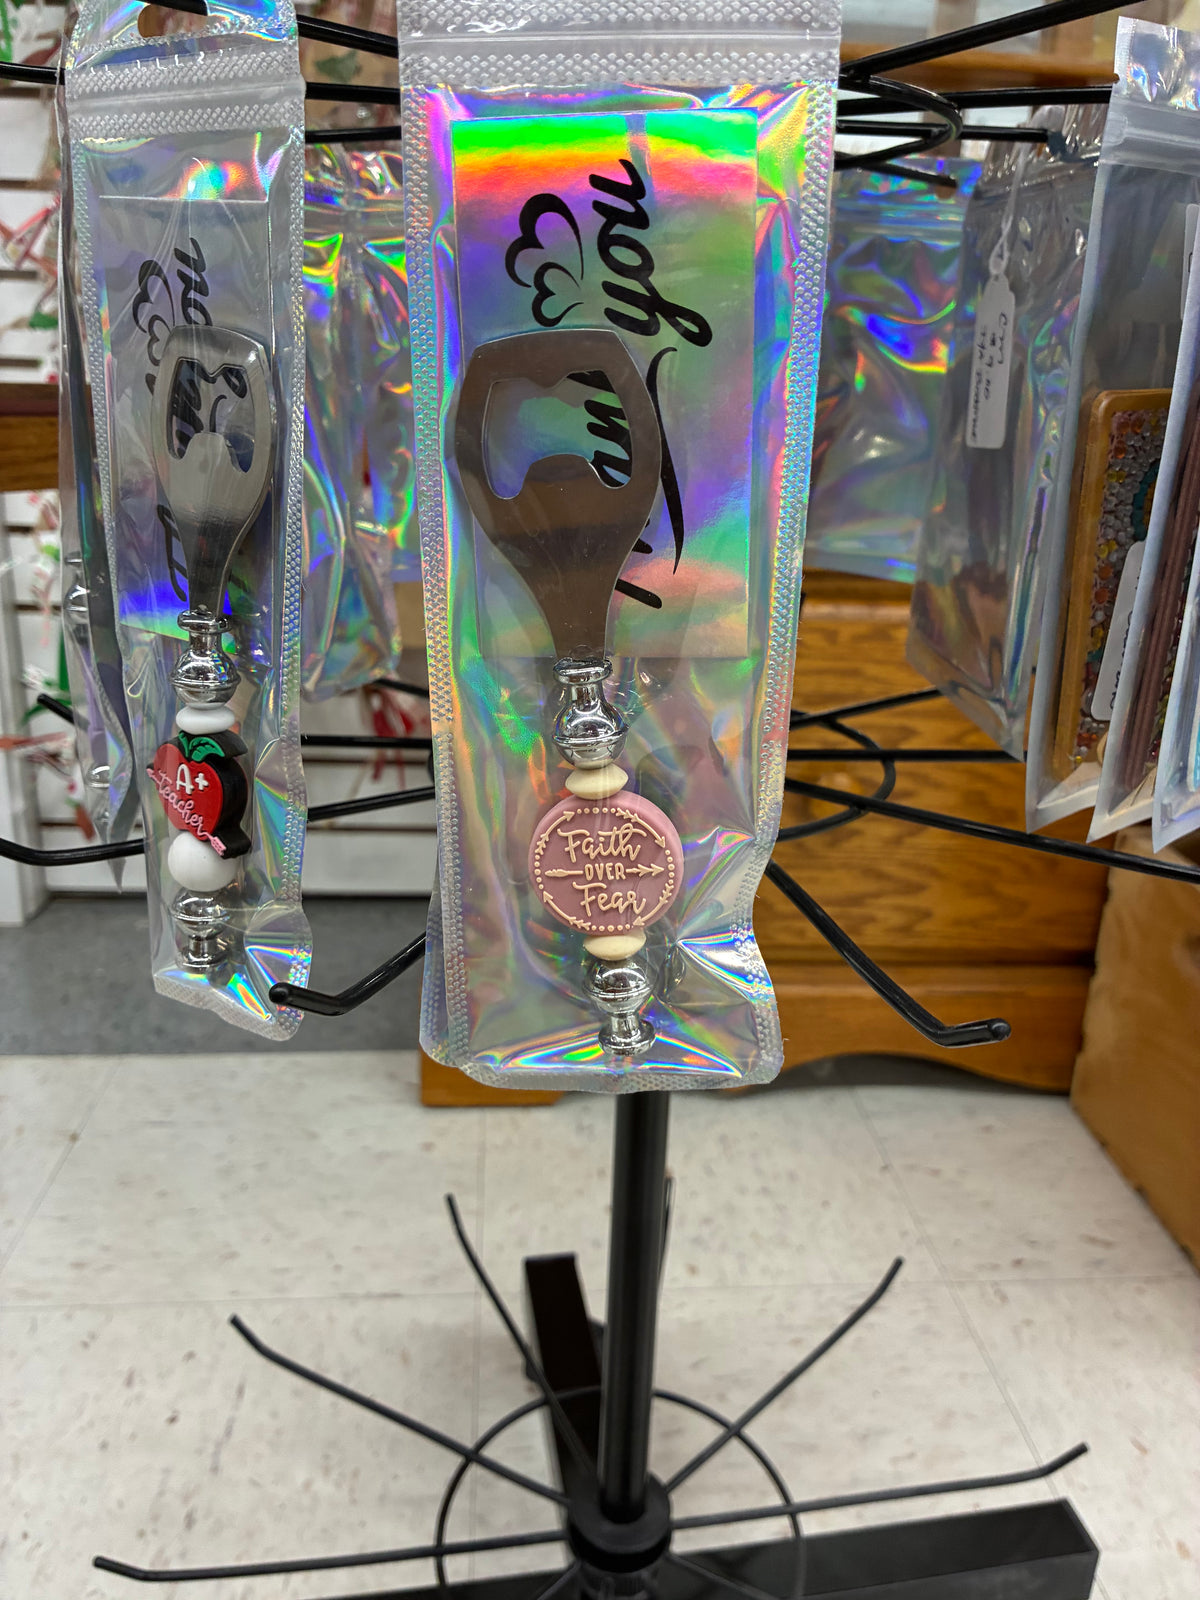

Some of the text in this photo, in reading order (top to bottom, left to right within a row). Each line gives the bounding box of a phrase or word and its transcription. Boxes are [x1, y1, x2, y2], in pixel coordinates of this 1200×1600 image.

[588, 158, 713, 347] you
[175, 763, 209, 795] A+
[156, 768, 206, 837] teacher
[556, 822, 647, 863] Faith
[584, 862, 627, 881] OVER
[572, 881, 647, 917] Fear
